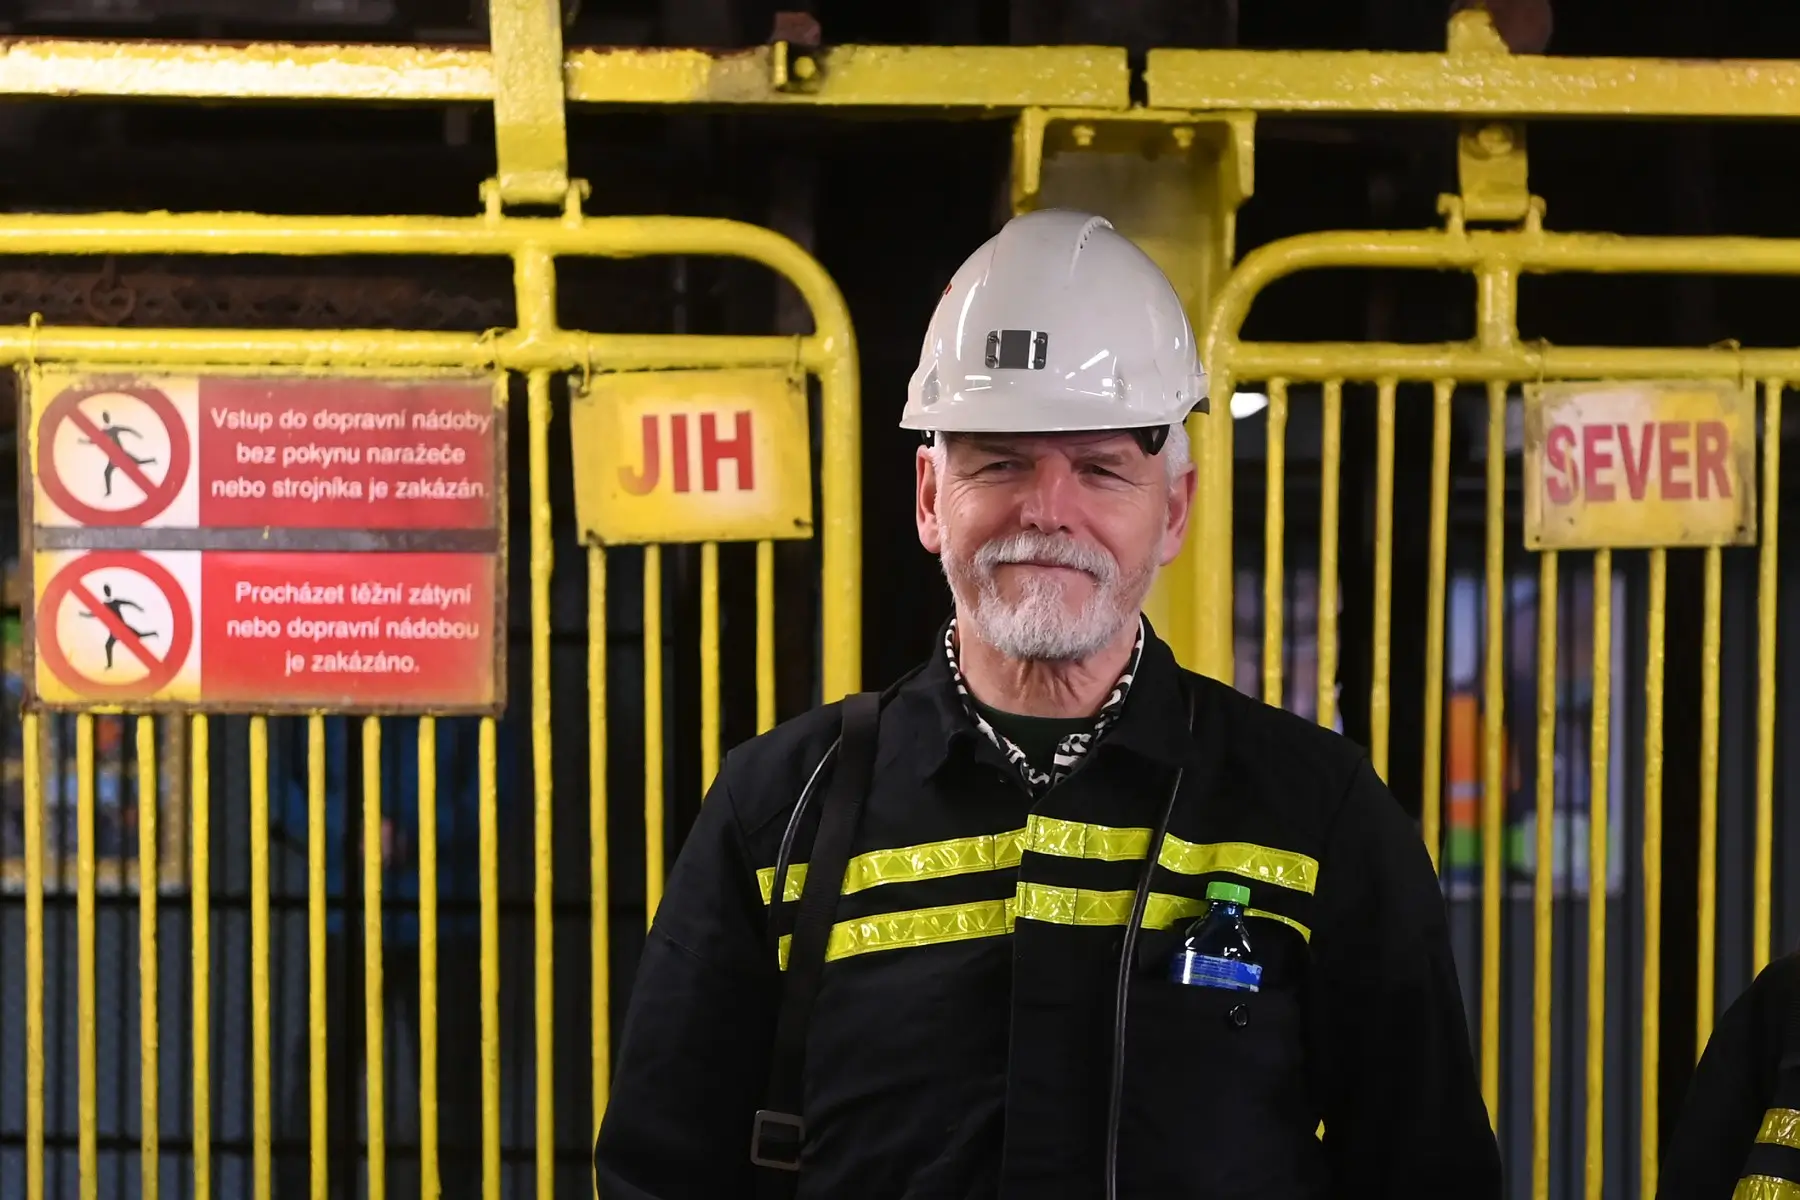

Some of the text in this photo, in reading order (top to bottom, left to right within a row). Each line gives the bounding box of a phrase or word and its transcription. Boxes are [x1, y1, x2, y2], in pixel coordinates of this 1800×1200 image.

[210, 407, 491, 435] Vstup do dopravní nádoby
[236, 442, 466, 469] bez pokynu naražeče
[617, 410, 754, 496] JIH
[1546, 420, 1733, 506] SEVER
[211, 477, 266, 498] nebo
[272, 476, 362, 502] strojníka
[369, 477, 388, 503] je
[235, 581, 472, 610] Procházet těžní zátyní
[226, 616, 480, 642] nebo dopravní nádobou
[284, 650, 420, 677] je zakázáno.
